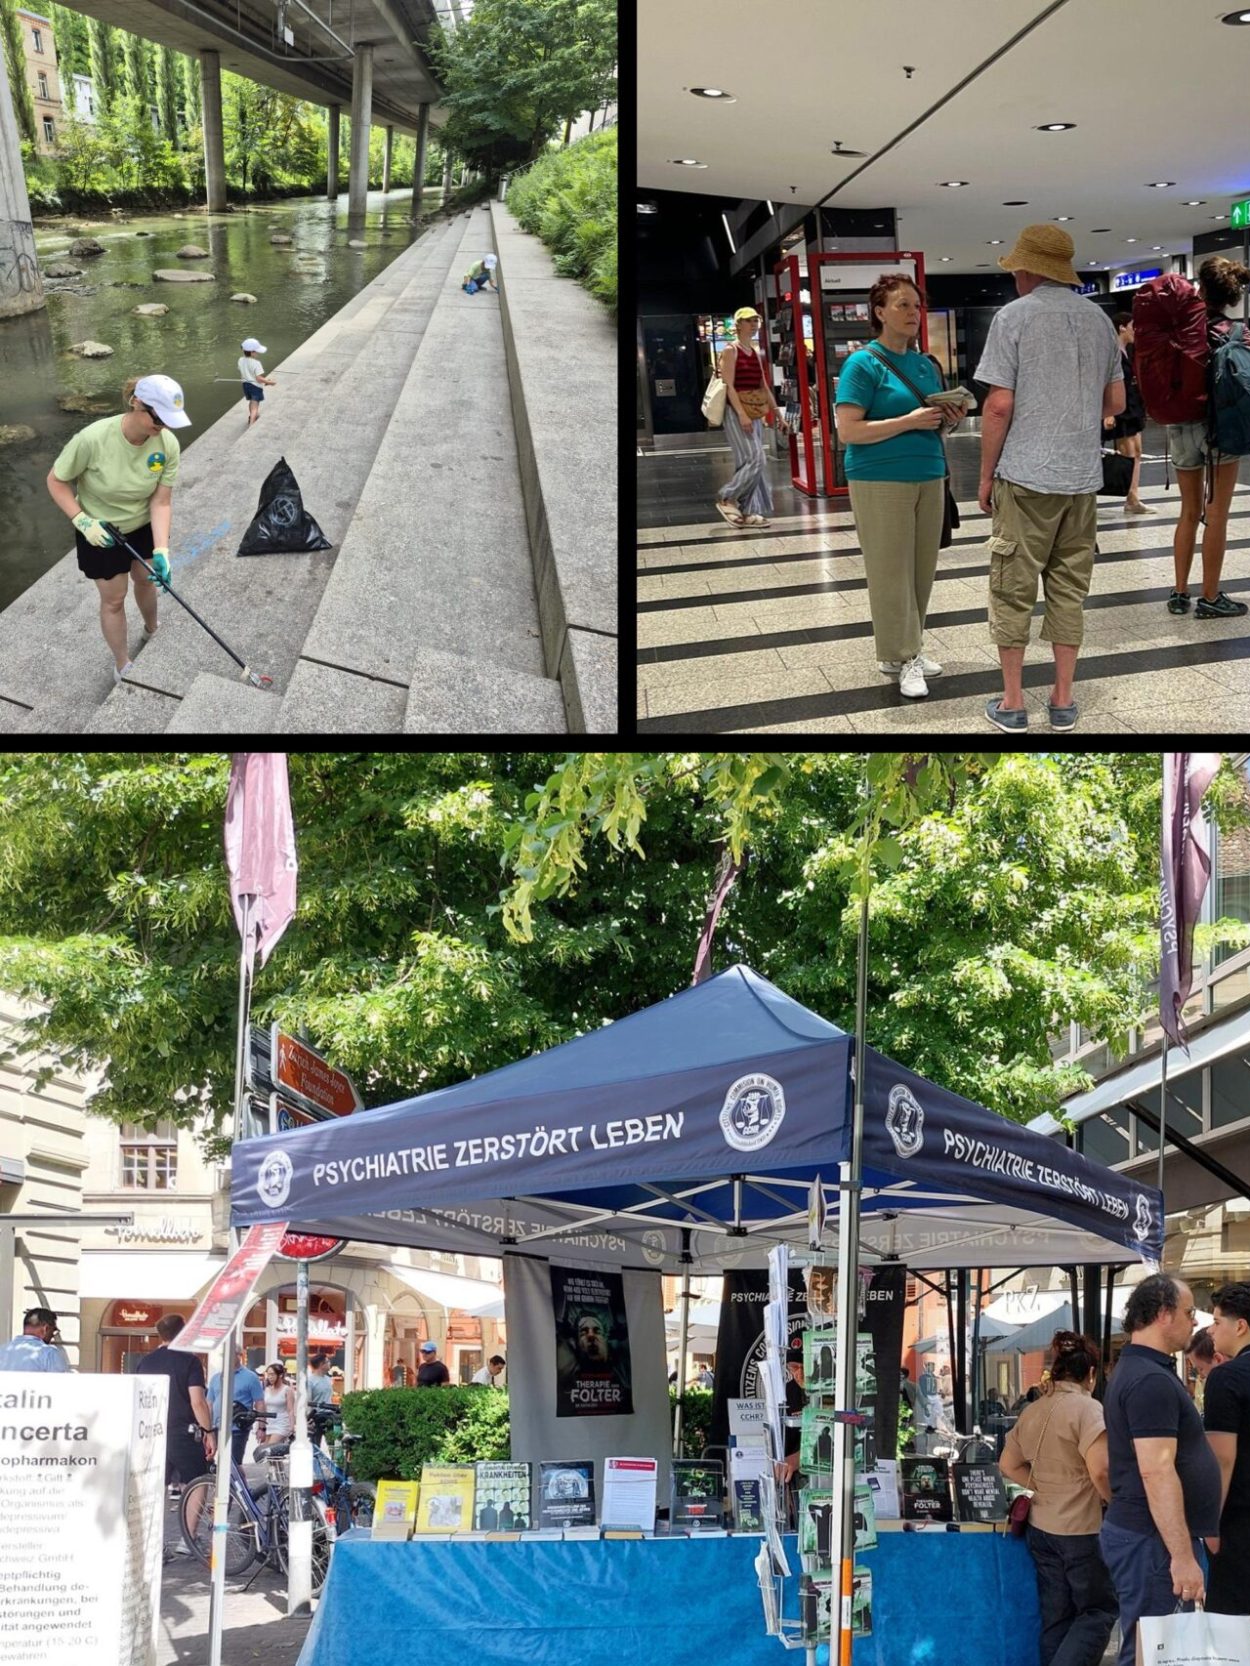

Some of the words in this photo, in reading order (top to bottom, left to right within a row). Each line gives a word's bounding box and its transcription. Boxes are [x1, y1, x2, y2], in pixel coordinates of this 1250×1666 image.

[312, 1144, 449, 1188] PSYCHIATRIE
[455, 1125, 583, 1168] ZERSTÖRT
[589, 1111, 686, 1151] LEBEN
[942, 1128, 1037, 1184] PSYCHIATRIE
[1036, 1163, 1101, 1207] ZERSTÖRT
[1098, 1192, 1130, 1220] LEBEN
[866, 1290, 894, 1301] EBEN
[570, 1388, 621, 1403] FOLTER
[737, 1402, 752, 1410] WAS
[1, 1423, 89, 1441] ncerta
[1, 1455, 98, 1468] opharmakon
[480, 1470, 528, 1479] KRANKHEITEN
[58, 1608, 81, 1617] und
[22, 1620, 92, 1632] angewendet
